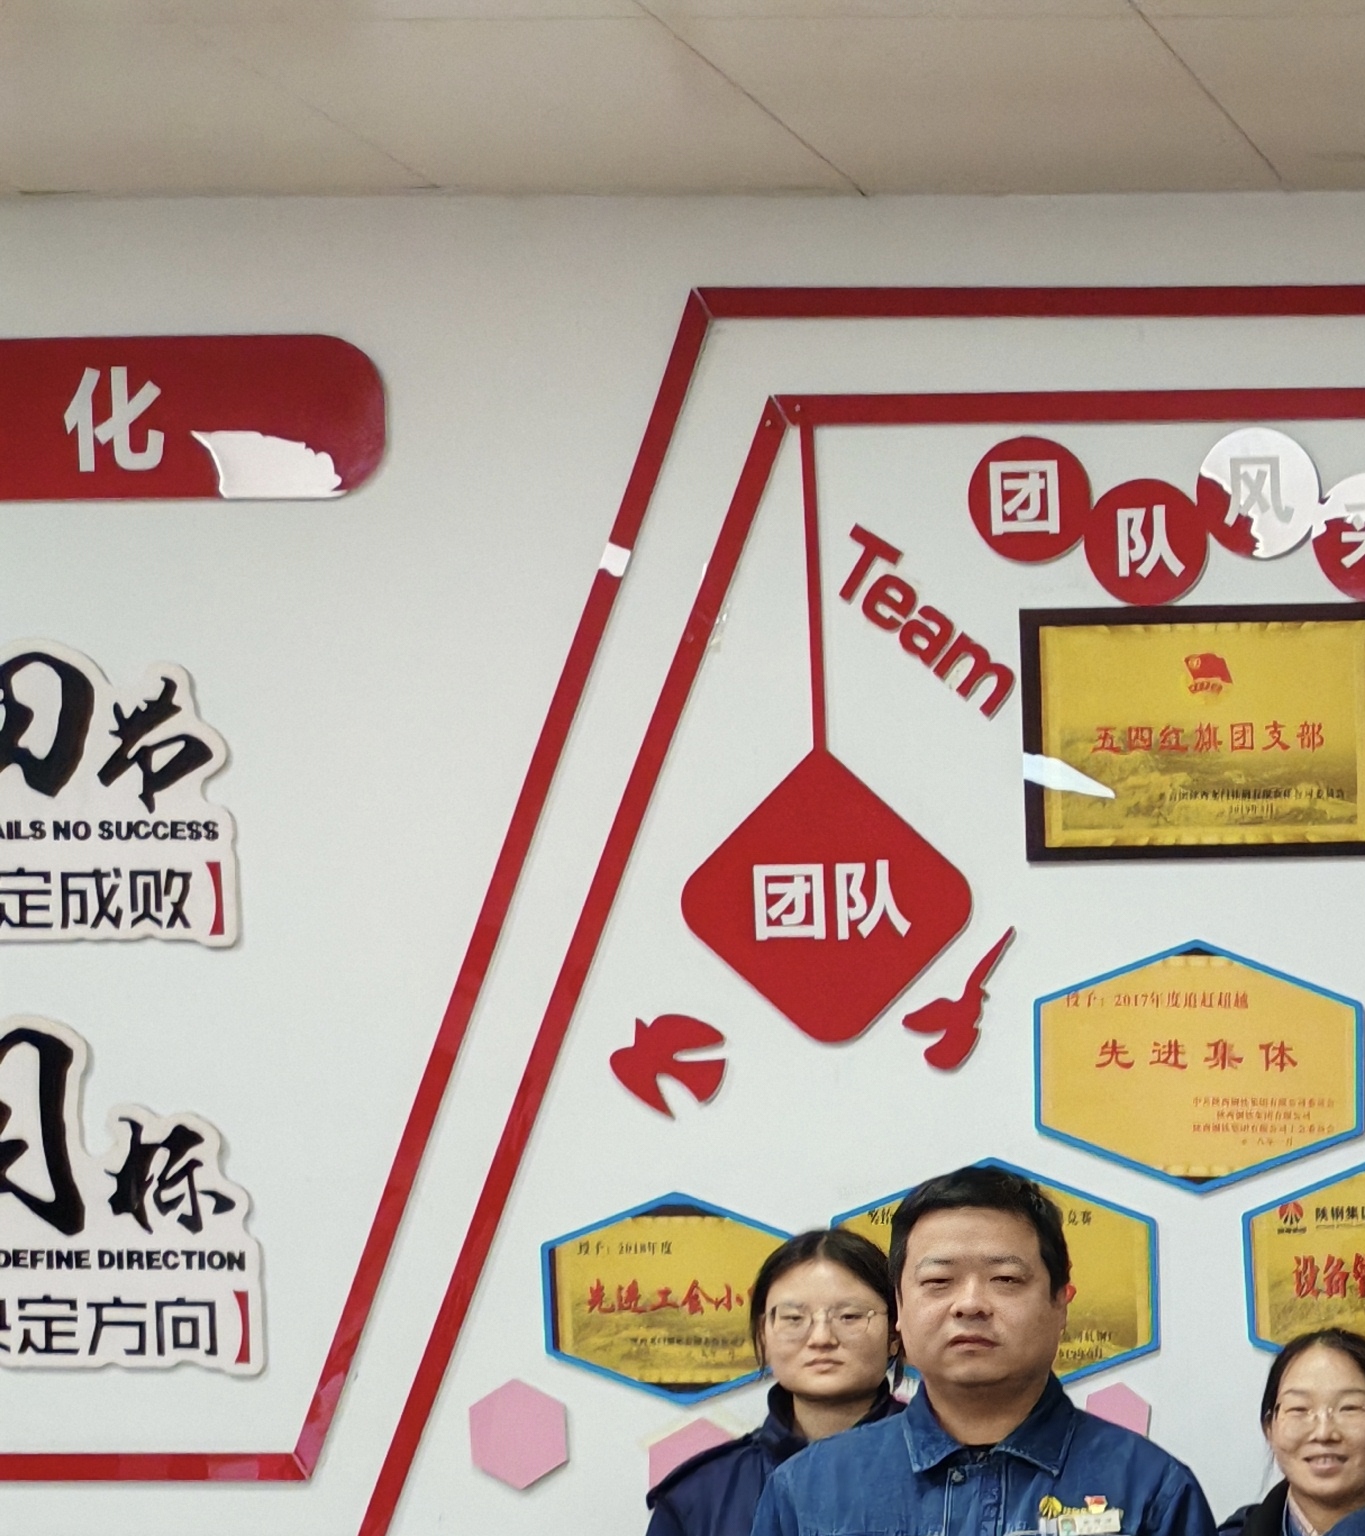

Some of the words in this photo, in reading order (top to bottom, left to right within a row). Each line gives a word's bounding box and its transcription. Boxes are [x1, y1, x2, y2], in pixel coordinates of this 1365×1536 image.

[64, 366, 165, 472] 化
[838, 524, 1016, 721] Team
[1091, 719, 1326, 757] 五四红旗团支部
[53, 820, 92, 841] NO
[98, 820, 220, 841] SUCCESS
[752, 858, 912, 942] 团队
[1094, 1038, 1299, 1073] 先进集体
[98, 1248, 247, 1272] DIRECTION
[586, 1278, 753, 1315] 先进工会小
